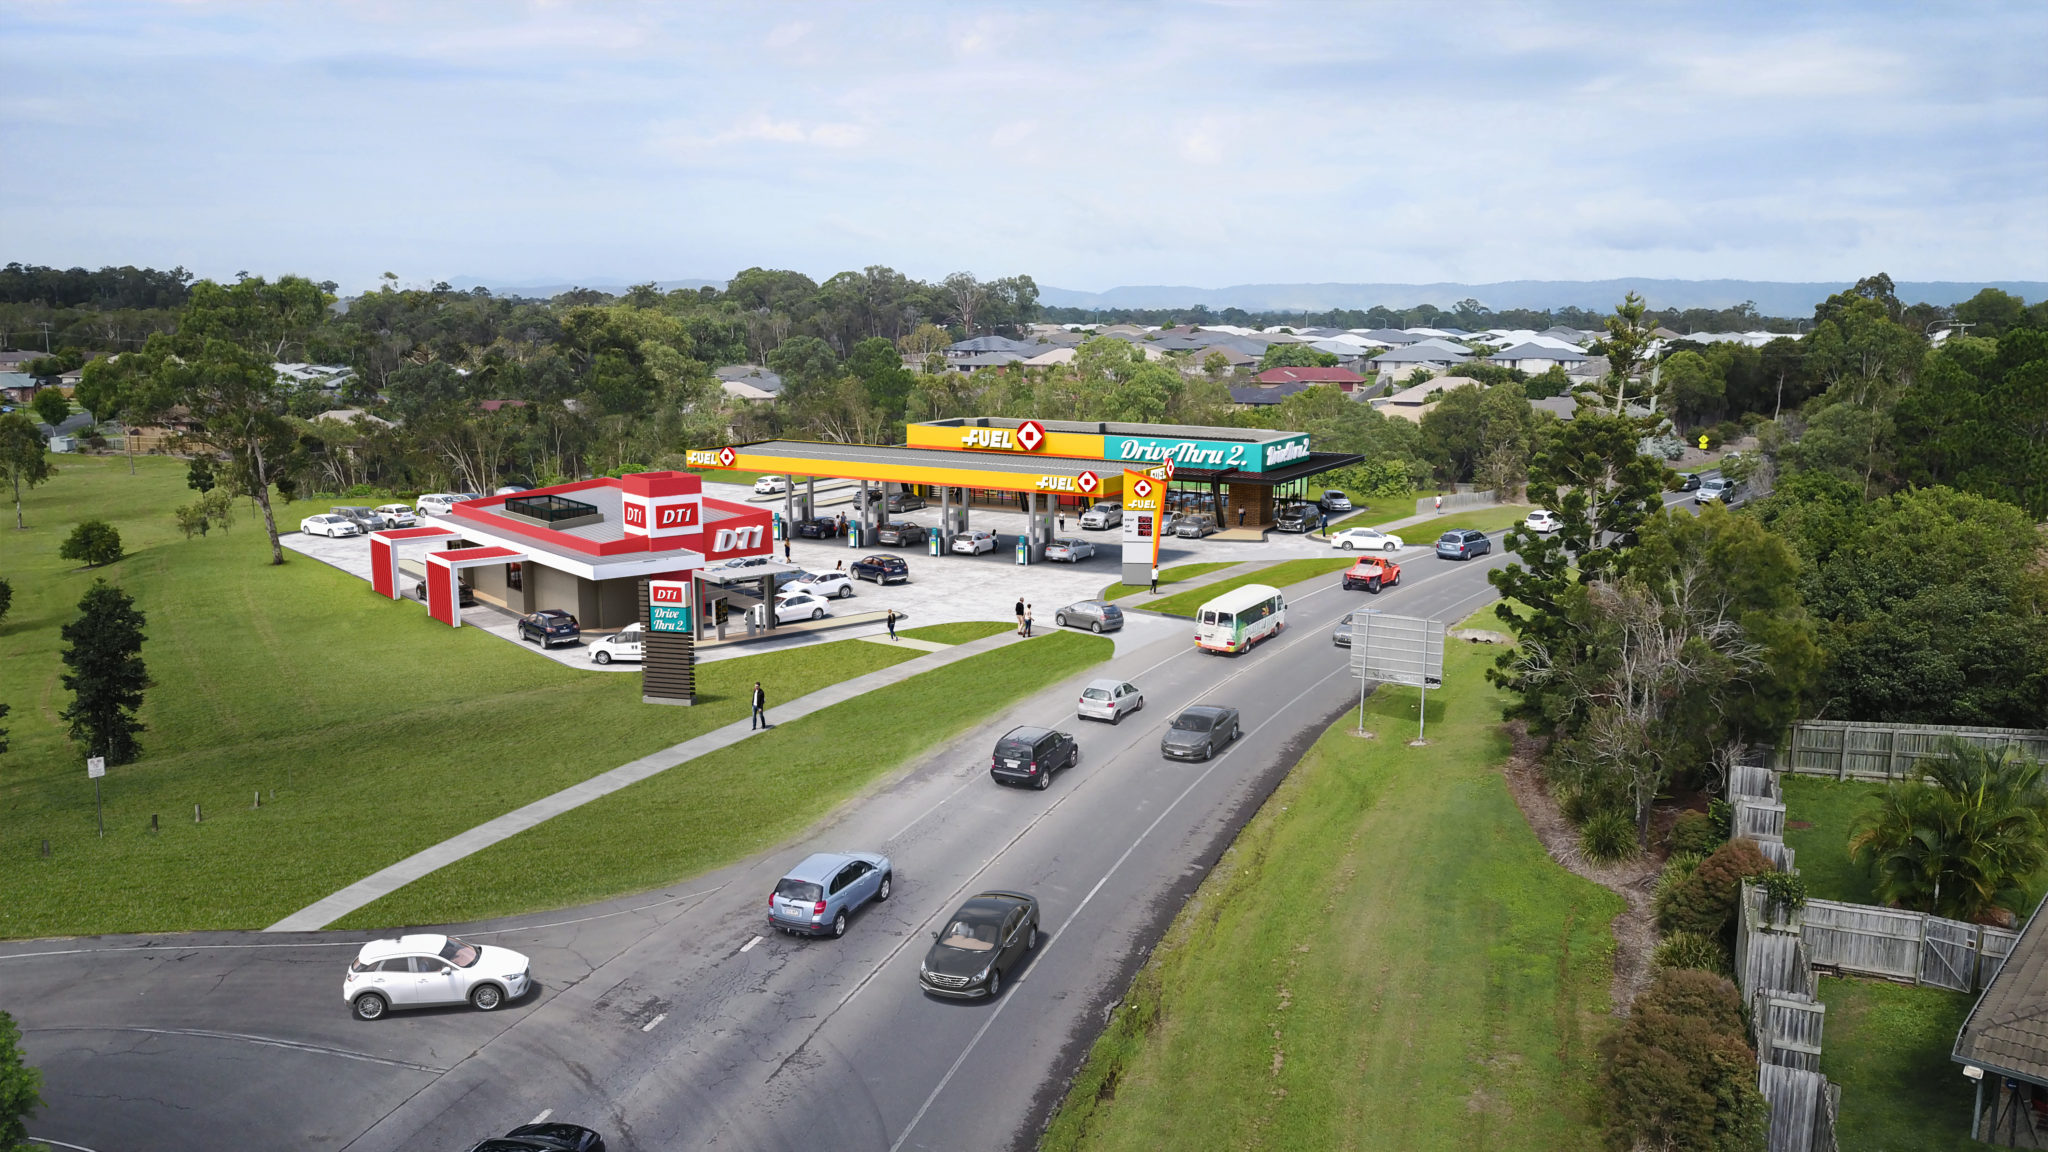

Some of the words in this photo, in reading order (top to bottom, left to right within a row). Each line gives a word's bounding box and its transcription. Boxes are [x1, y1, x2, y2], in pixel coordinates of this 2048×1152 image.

[962, 429, 1013, 449] FUEL
[687, 452, 718, 465] FUEL
[1226, 445, 1248, 466] 2.
[1036, 476, 1075, 491] FUEL
[1128, 499, 1157, 509] FUEL
[627, 507, 643, 524] DT1
[662, 508, 692, 525] DT1
[712, 525, 764, 552] DT1
[657, 589, 678, 600] DT1
[654, 608, 680, 619] Drive
[653, 619, 675, 631] Thru
[675, 620, 686, 631] 2.
